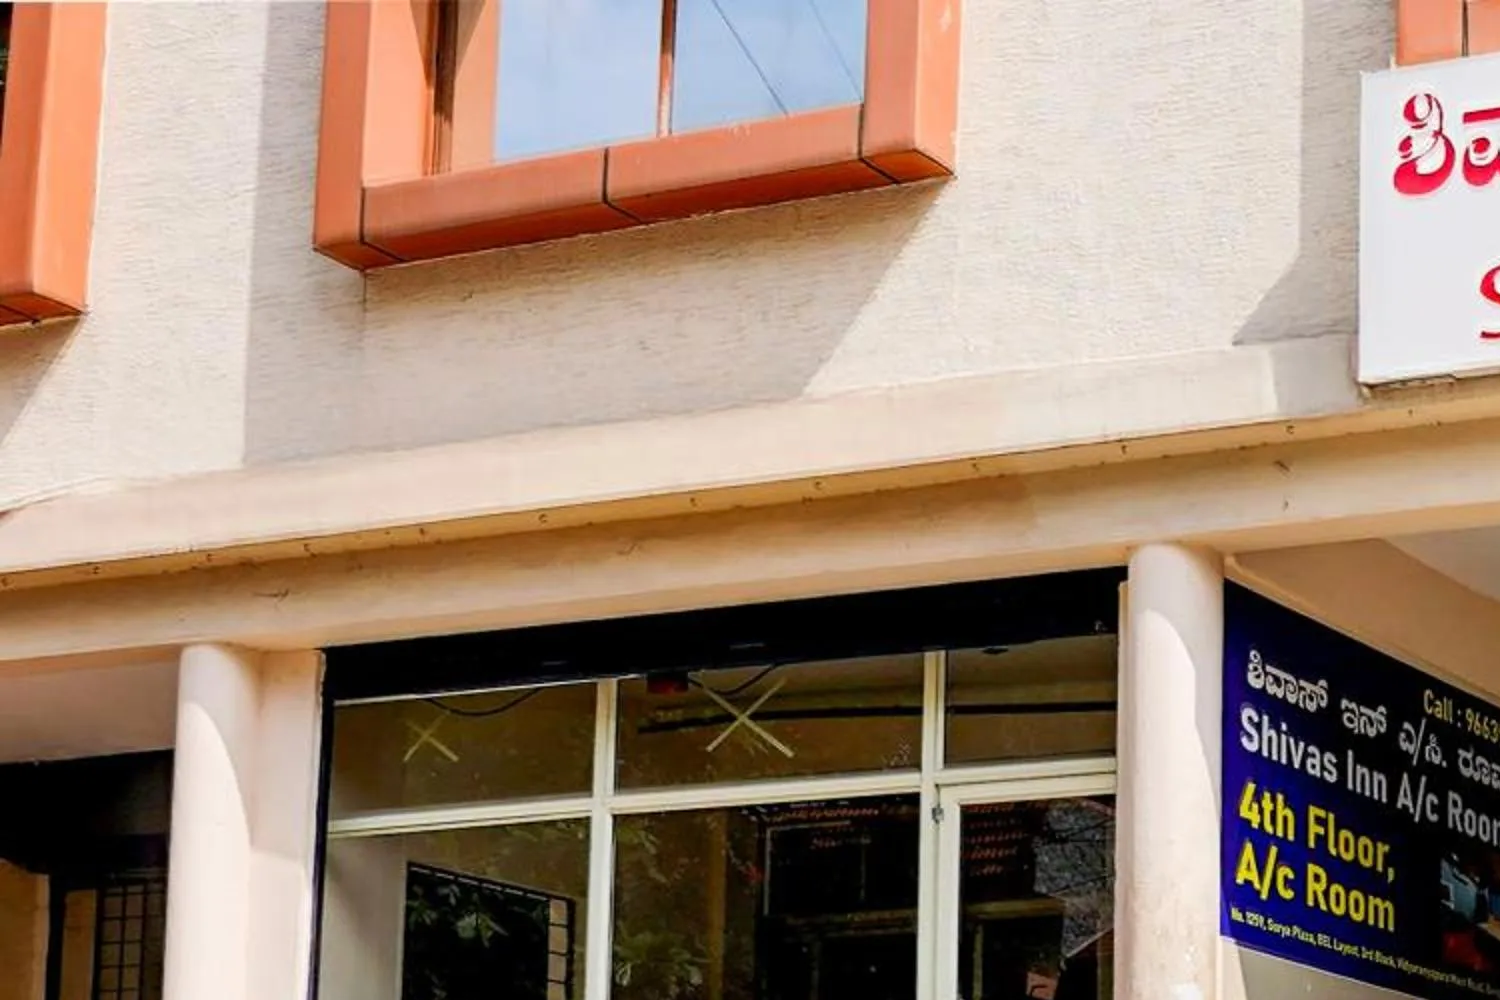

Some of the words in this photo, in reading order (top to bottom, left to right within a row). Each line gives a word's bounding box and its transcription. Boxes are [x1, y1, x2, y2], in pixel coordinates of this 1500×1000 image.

[1247, 649, 1329, 713] ಶಿವಾಸ್
[1423, 688, 1455, 723] Call
[1240, 706, 1338, 784] Shivas
[1347, 749, 1388, 804] Inn
[1396, 770, 1440, 824] A/c
[1239, 781, 1295, 842] 4th
[1307, 804, 1395, 883] Floor,
[1235, 840, 1295, 900] A/c
[1306, 863, 1395, 933] Room
